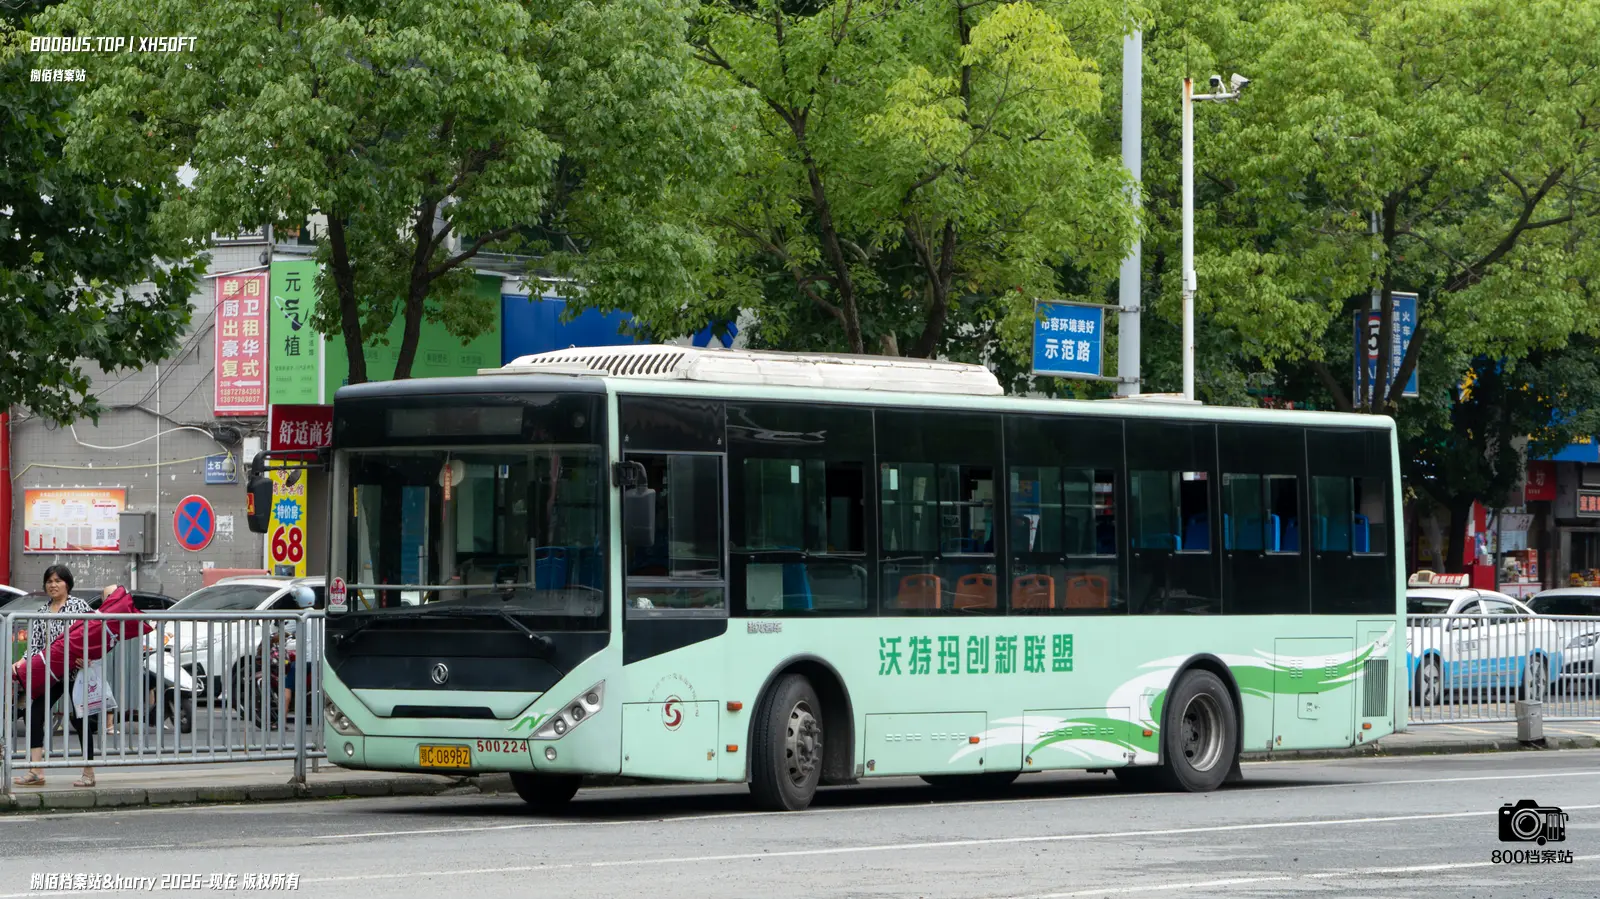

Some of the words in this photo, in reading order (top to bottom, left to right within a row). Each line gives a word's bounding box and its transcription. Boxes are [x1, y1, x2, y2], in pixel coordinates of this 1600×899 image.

[222, 279, 260, 297] 单间
[222, 299, 260, 317] 厨卫
[222, 319, 260, 337] 出租
[221, 339, 260, 358] 豪华
[1044, 338, 1091, 362] 示范路
[221, 359, 260, 378] 复式
[277, 505, 299, 519] 特价房
[271, 526, 304, 563] 68
[878, 634, 1074, 675] 沃特玛创新联盟
[477, 740, 528, 753] 500224
